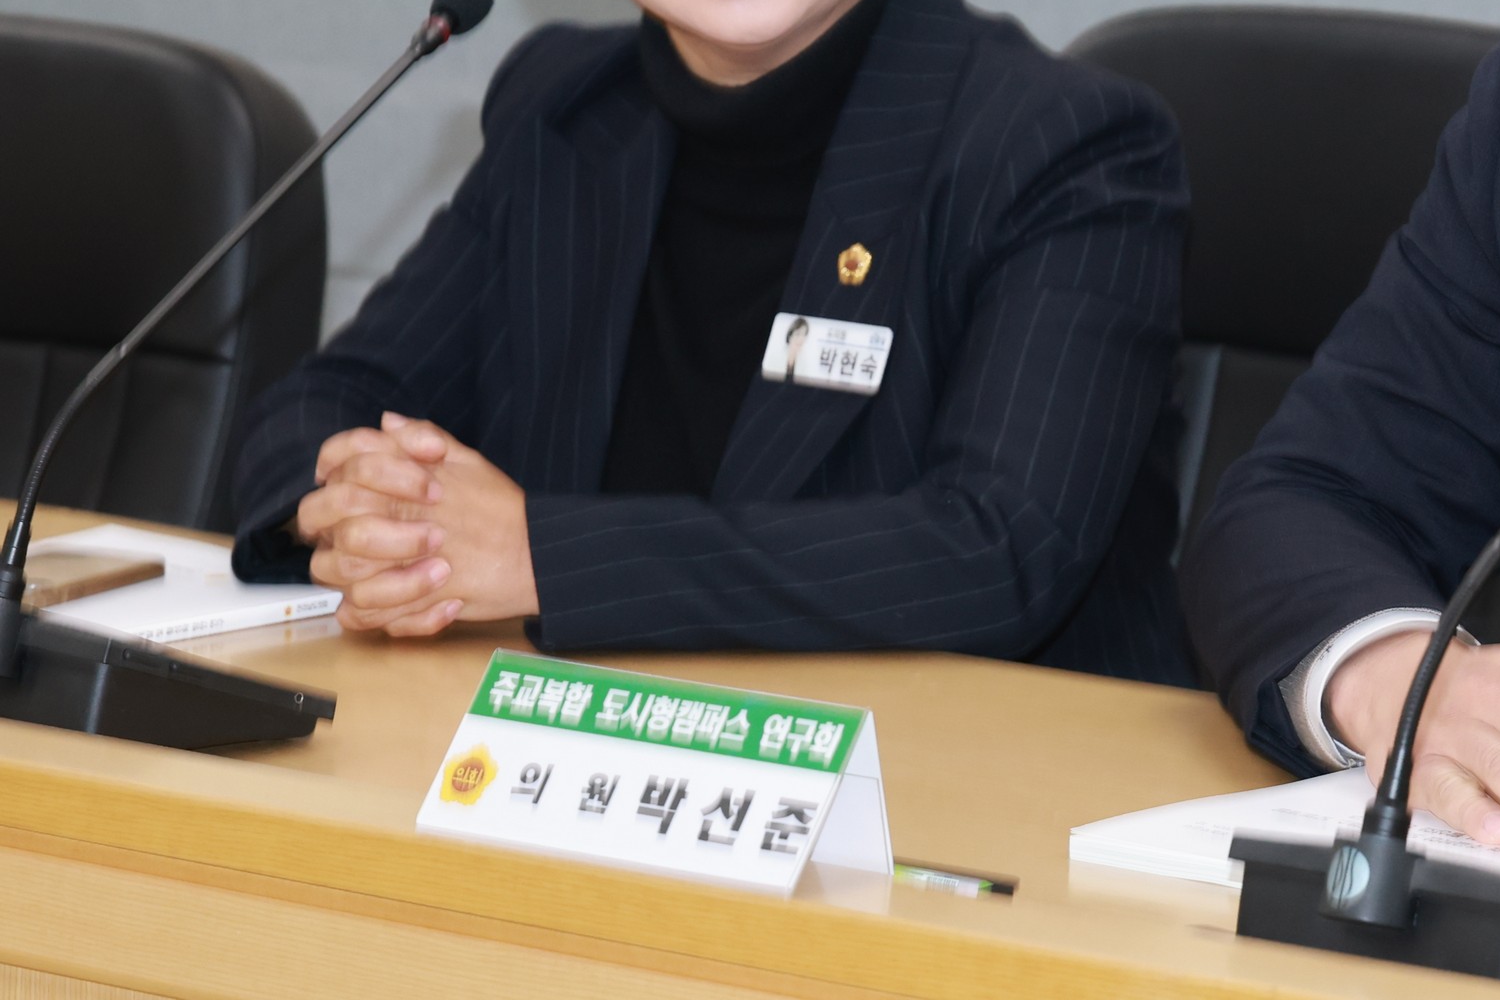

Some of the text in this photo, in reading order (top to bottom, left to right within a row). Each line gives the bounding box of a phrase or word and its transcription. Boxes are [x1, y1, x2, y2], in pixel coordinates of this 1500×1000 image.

[489, 671, 844, 760] 주교복합 도시형캠퍼스 연구회
